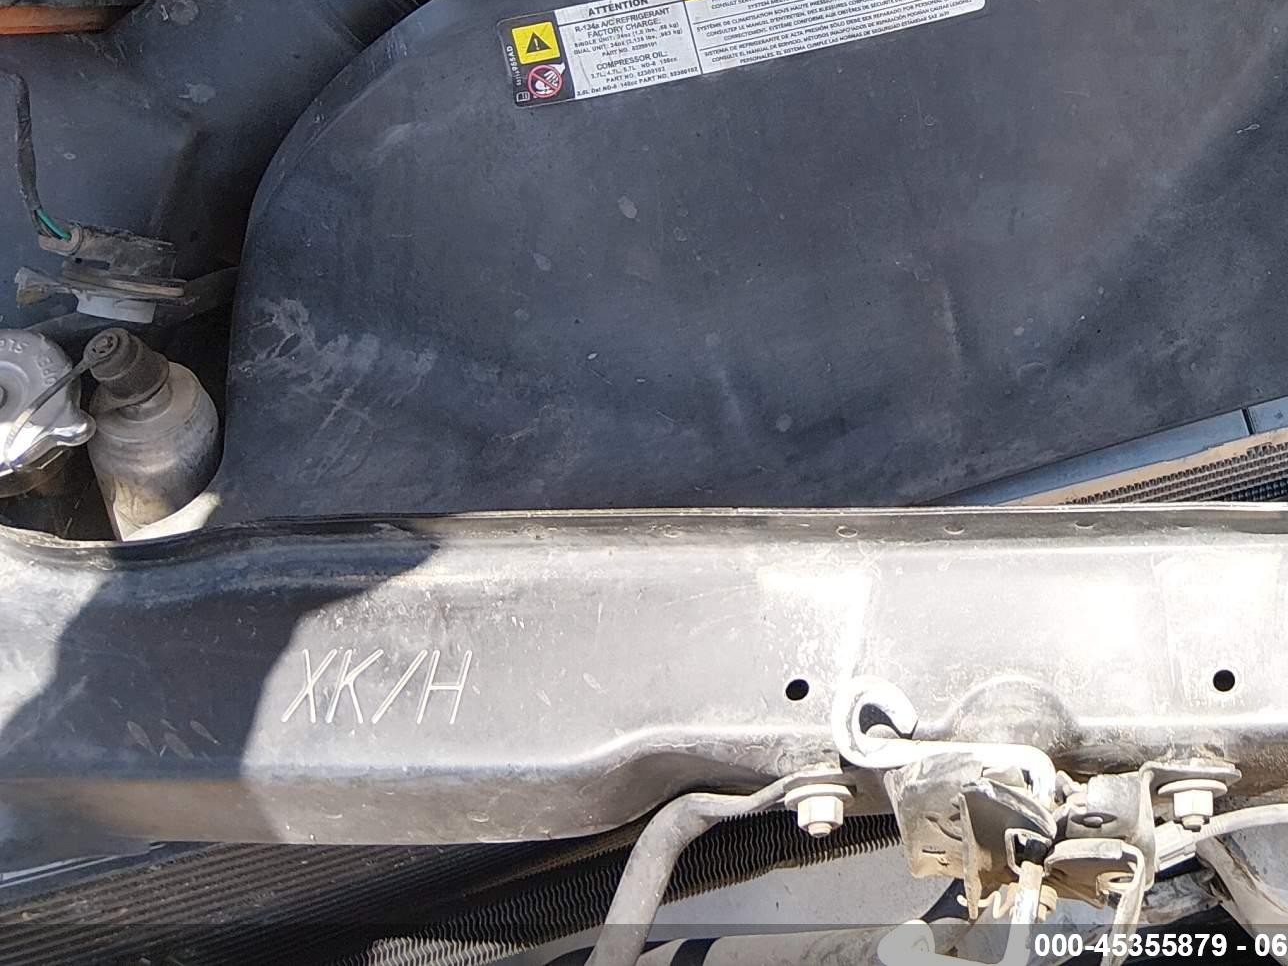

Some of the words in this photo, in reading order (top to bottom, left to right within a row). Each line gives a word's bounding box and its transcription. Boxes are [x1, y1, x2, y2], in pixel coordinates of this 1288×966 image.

[711, 0, 736, 9] CONSULT
[747, 0, 769, 9] SYSTEM
[574, 22, 599, 32] R-134a
[600, 19, 614, 27] A/C
[615, 7, 669, 24] REFRIGERANT
[587, 25, 624, 38] FACTORY
[574, 47, 591, 55] DUAL
[601, 49, 617, 57] PART
[596, 53, 651, 70] COMPRESSOR
[605, 75, 622, 83] PART
[638, 75, 655, 83] PART
[281, 649, 472, 723] XK/H
